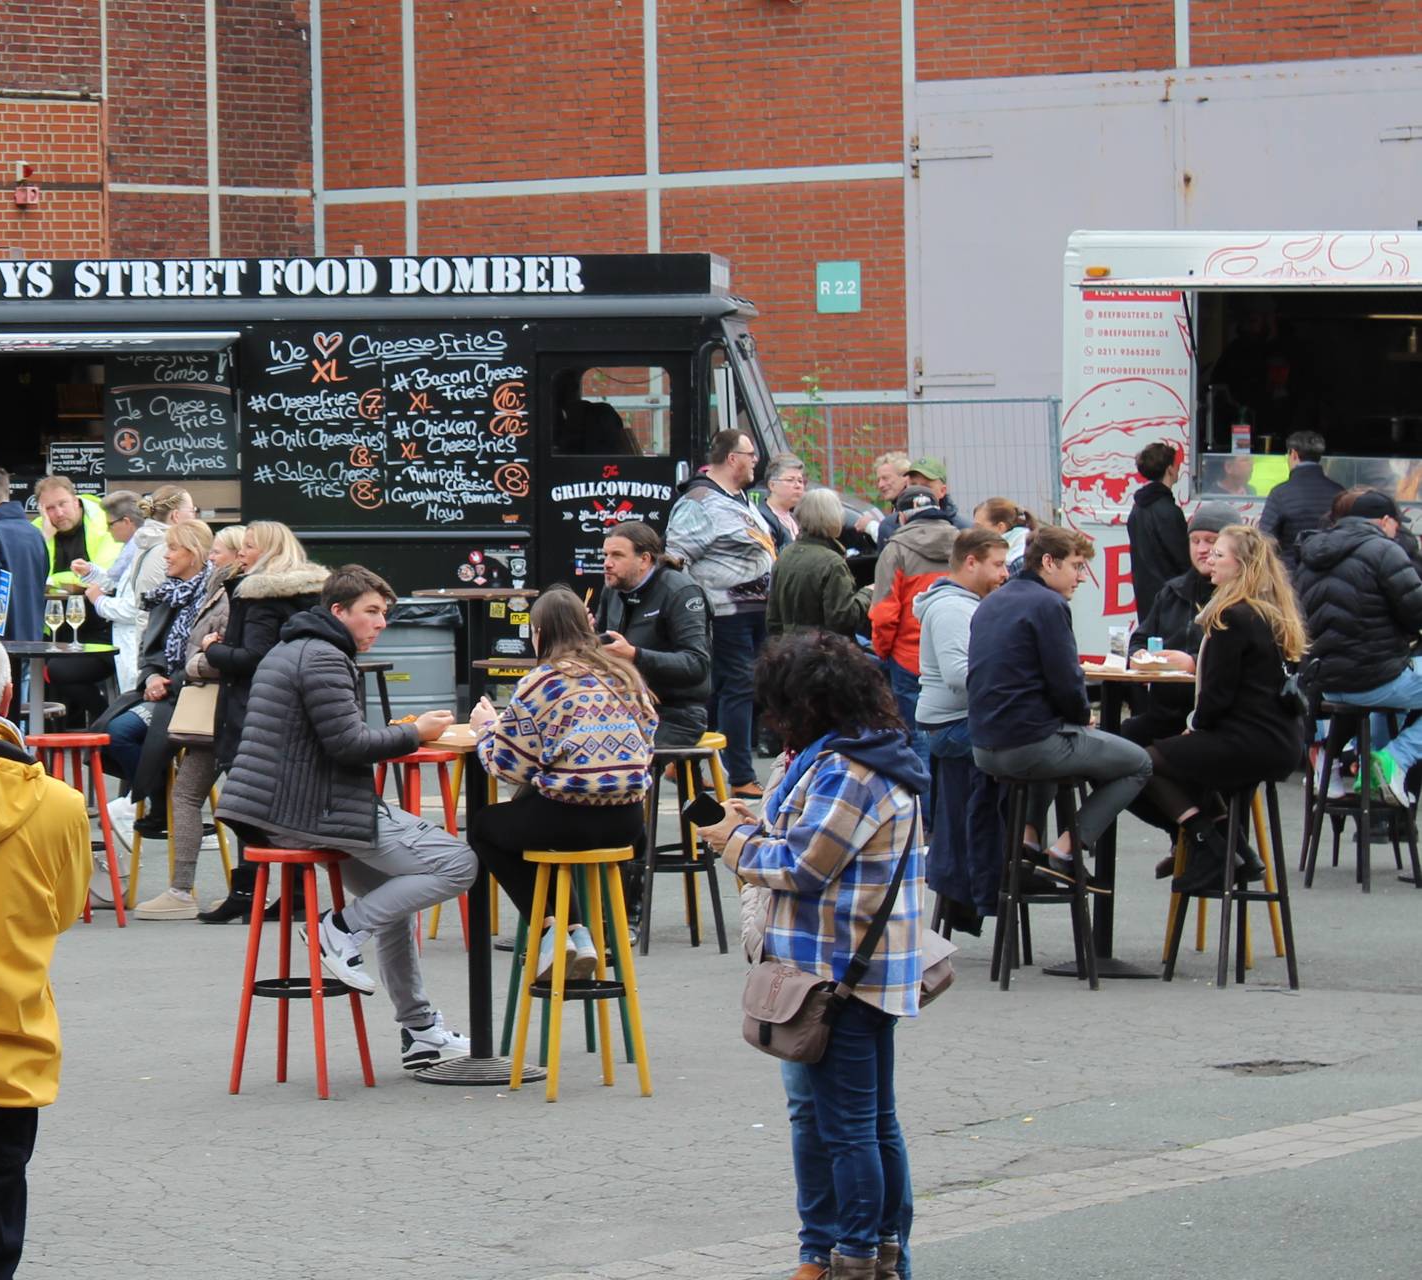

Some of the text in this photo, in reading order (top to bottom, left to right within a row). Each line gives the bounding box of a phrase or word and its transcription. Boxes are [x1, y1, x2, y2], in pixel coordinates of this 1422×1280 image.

[74, 261, 247, 297] STREET
[259, 258, 377, 296] FOOD
[389, 256, 584, 295] BOMBER
[820, 280, 857, 295] R 2.2
[1098, 311, 1163, 319] BEEFBUSTERS.DE
[269, 341, 309, 365] We
[311, 359, 348, 383] XL
[1097, 367, 1187, 376] INFO@BEEFBUSTERS.DE
[409, 391, 435, 414] XL
[436, 384, 489, 401] Fries
[294, 406, 359, 422] Classic
[400, 442, 424, 460] XL
[165, 451, 227, 475] Aufpreis
[299, 481, 346, 499] Fries
[444, 480, 496, 492] Classic
[551, 481, 672, 502] GRILLCOWBOYS
[425, 503, 465, 523] Mayo
